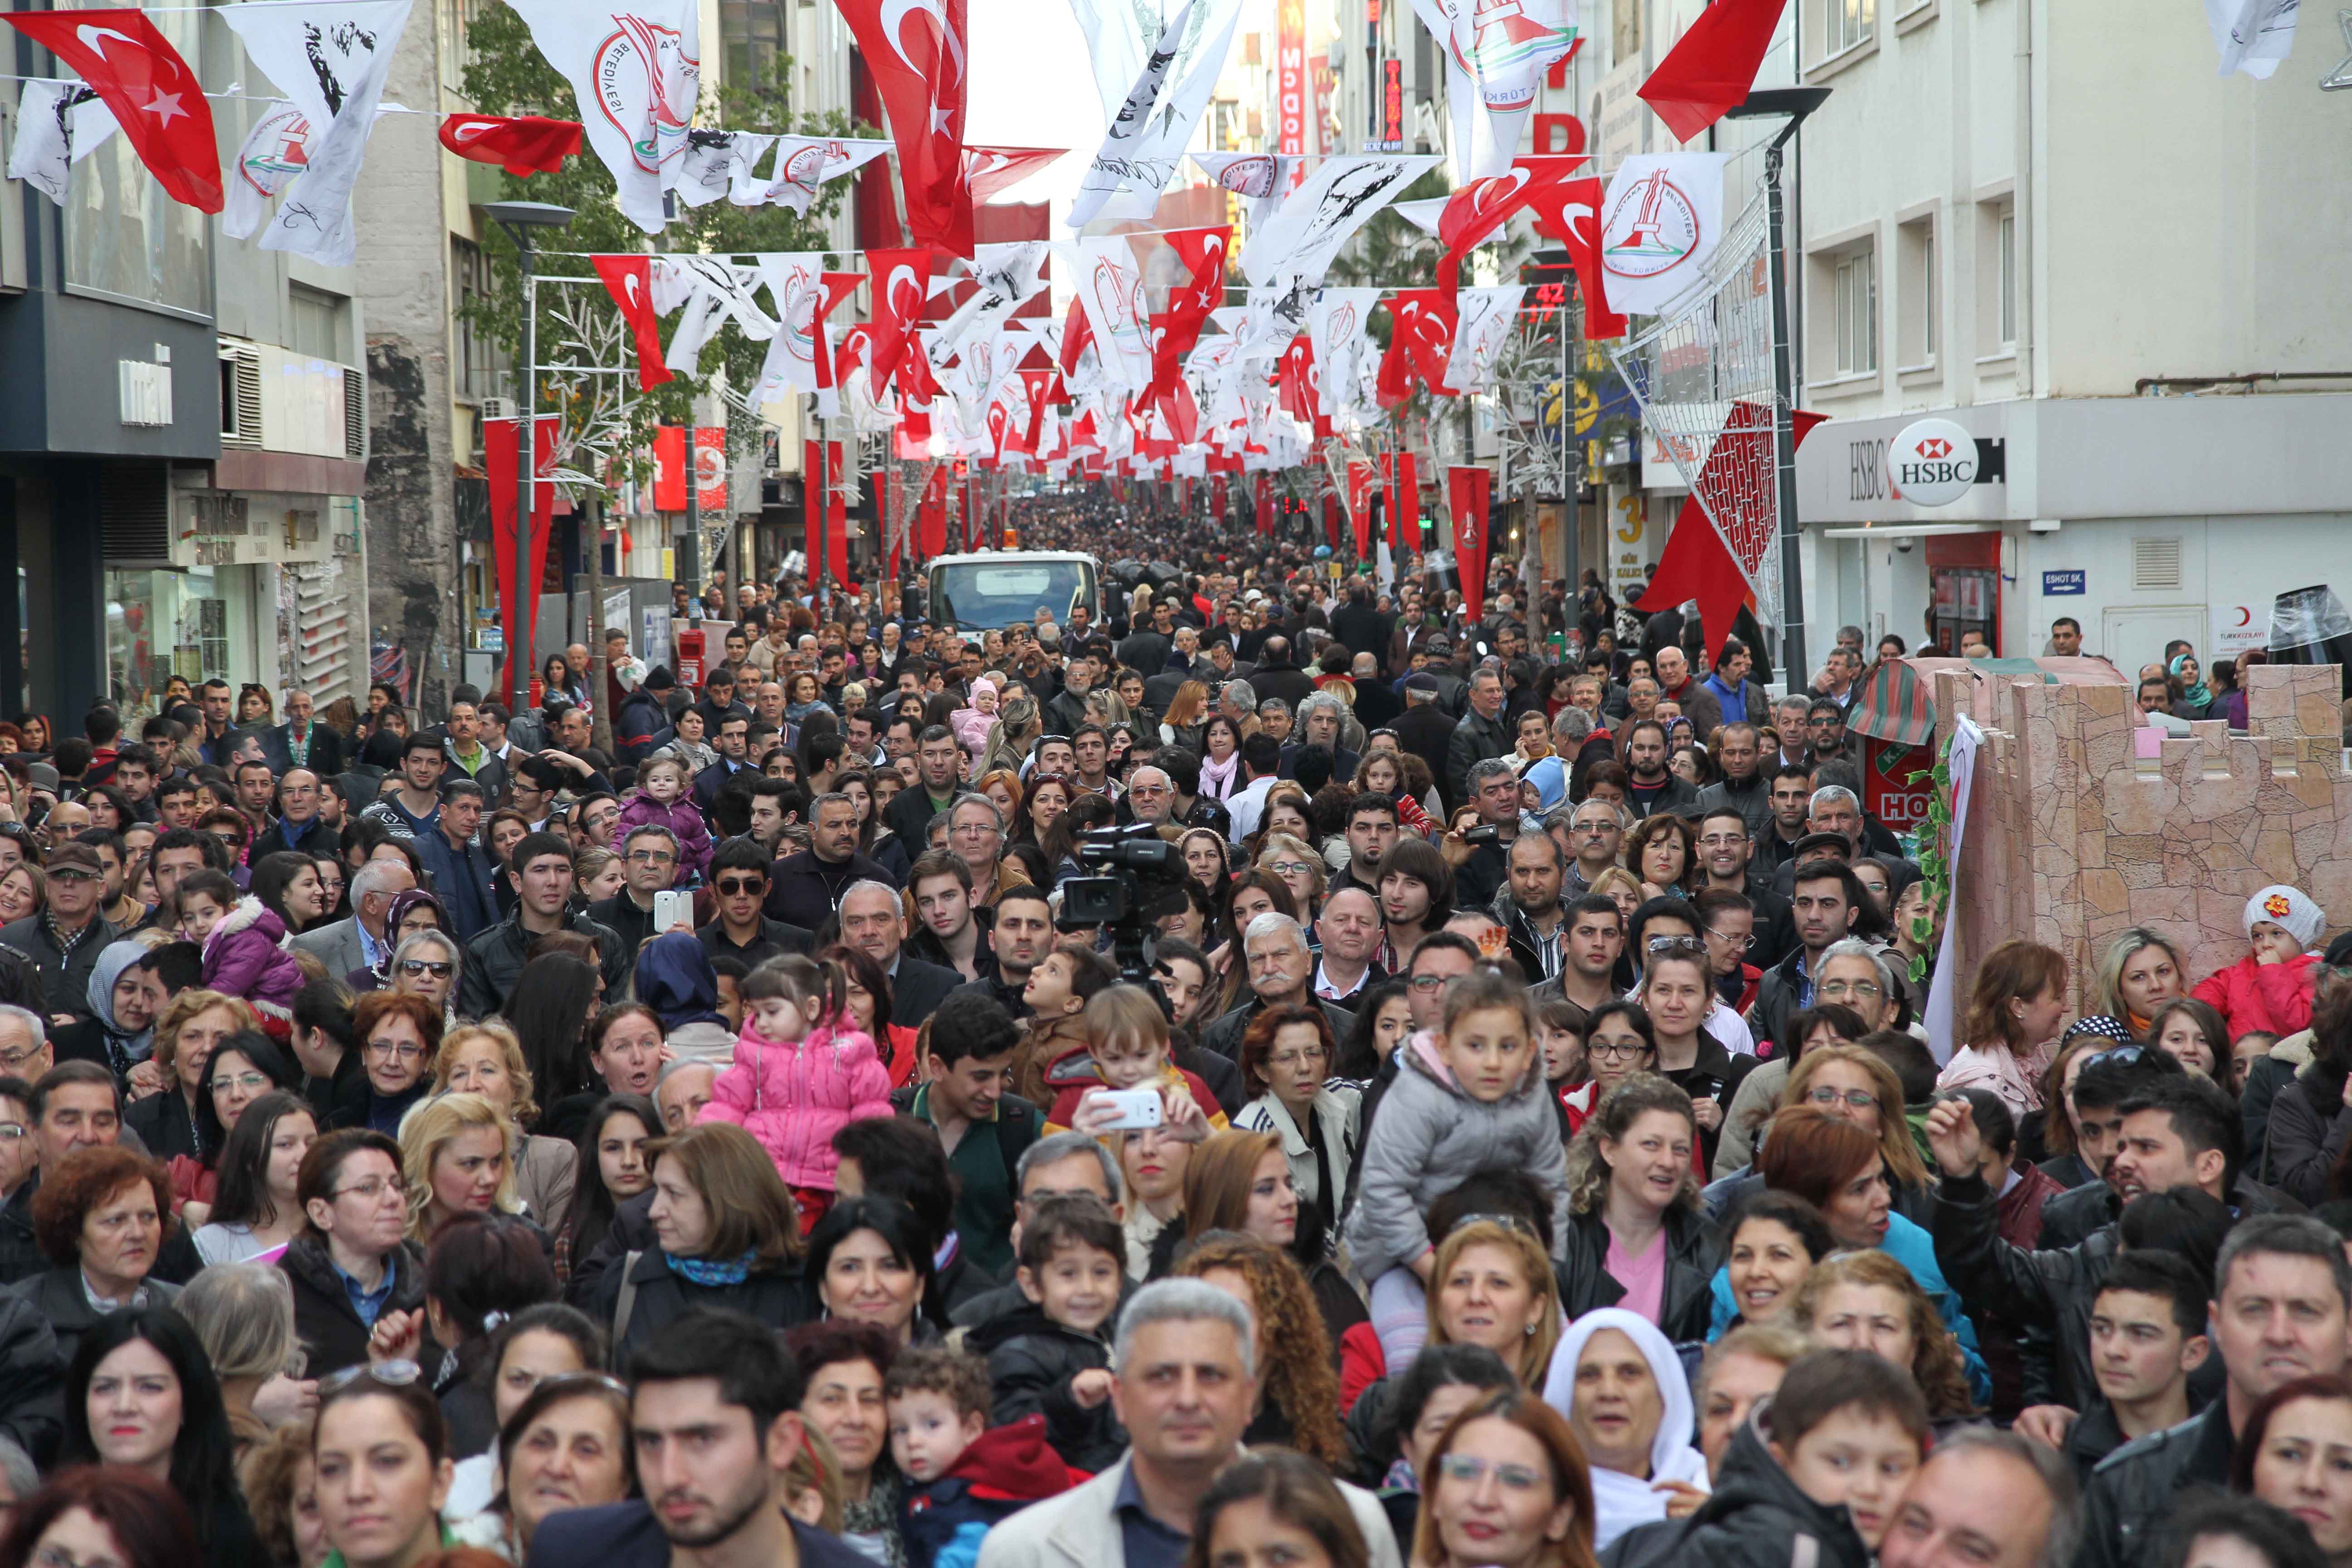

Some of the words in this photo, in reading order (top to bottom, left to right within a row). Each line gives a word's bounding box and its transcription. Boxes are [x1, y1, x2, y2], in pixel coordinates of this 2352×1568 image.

[1666, 189, 1693, 238] BELEDİYESİ
[1850, 439, 1885, 501] HSBC
[1901, 461, 1972, 484] HSBC
[1617, 495, 1642, 544] 3
[2046, 574, 2068, 584] ESHOT
[2070, 573, 2083, 583] SK.
[1881, 793, 1931, 821] HO
